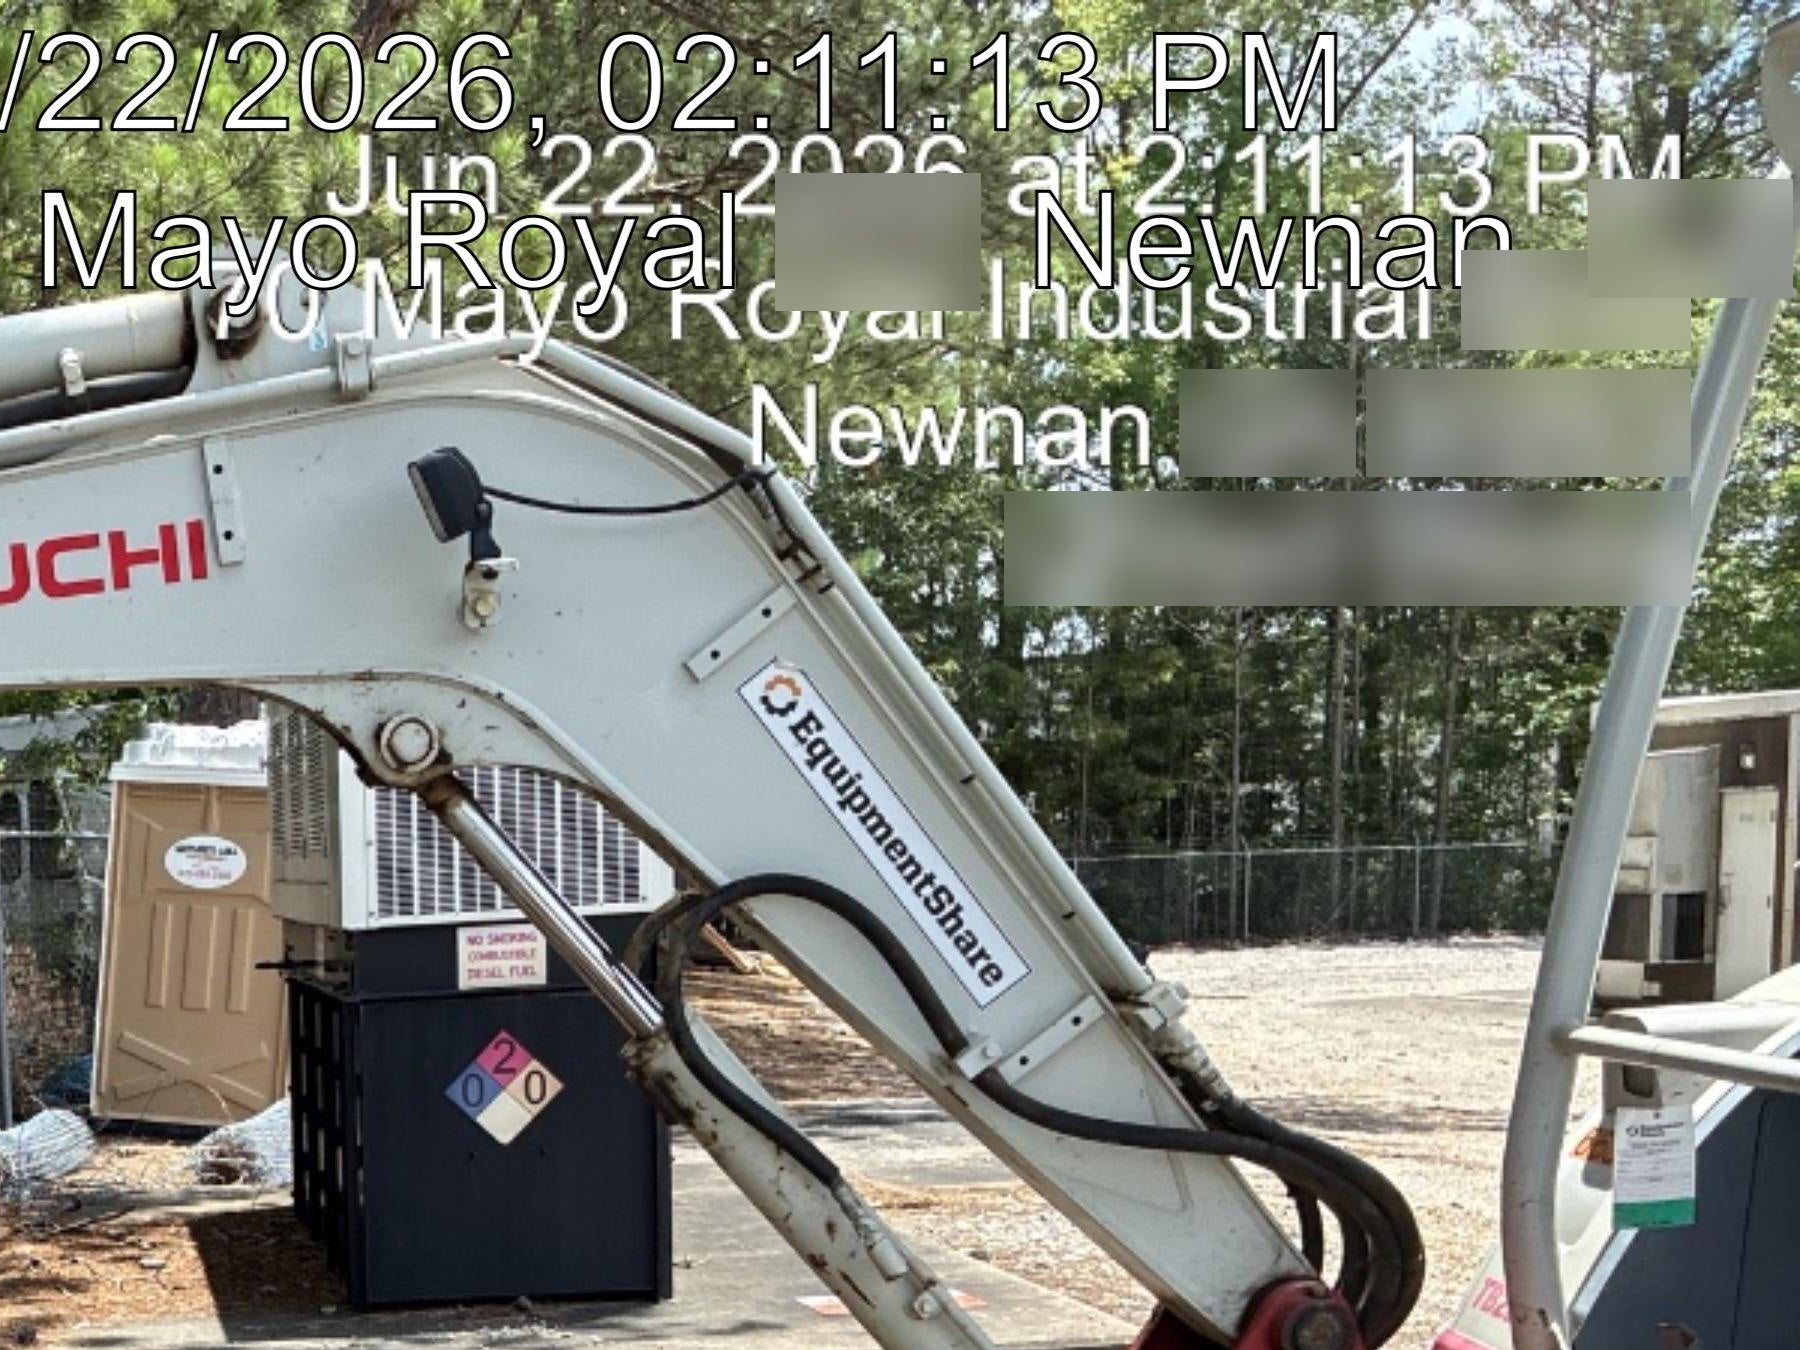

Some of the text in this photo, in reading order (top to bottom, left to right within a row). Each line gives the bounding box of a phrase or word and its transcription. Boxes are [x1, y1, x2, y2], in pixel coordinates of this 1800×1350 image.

[788, 709, 1004, 988] EquipmentShare
[491, 1038, 517, 1075] 2
[462, 1073, 484, 1109] 0
[524, 1070, 547, 1105] 0
